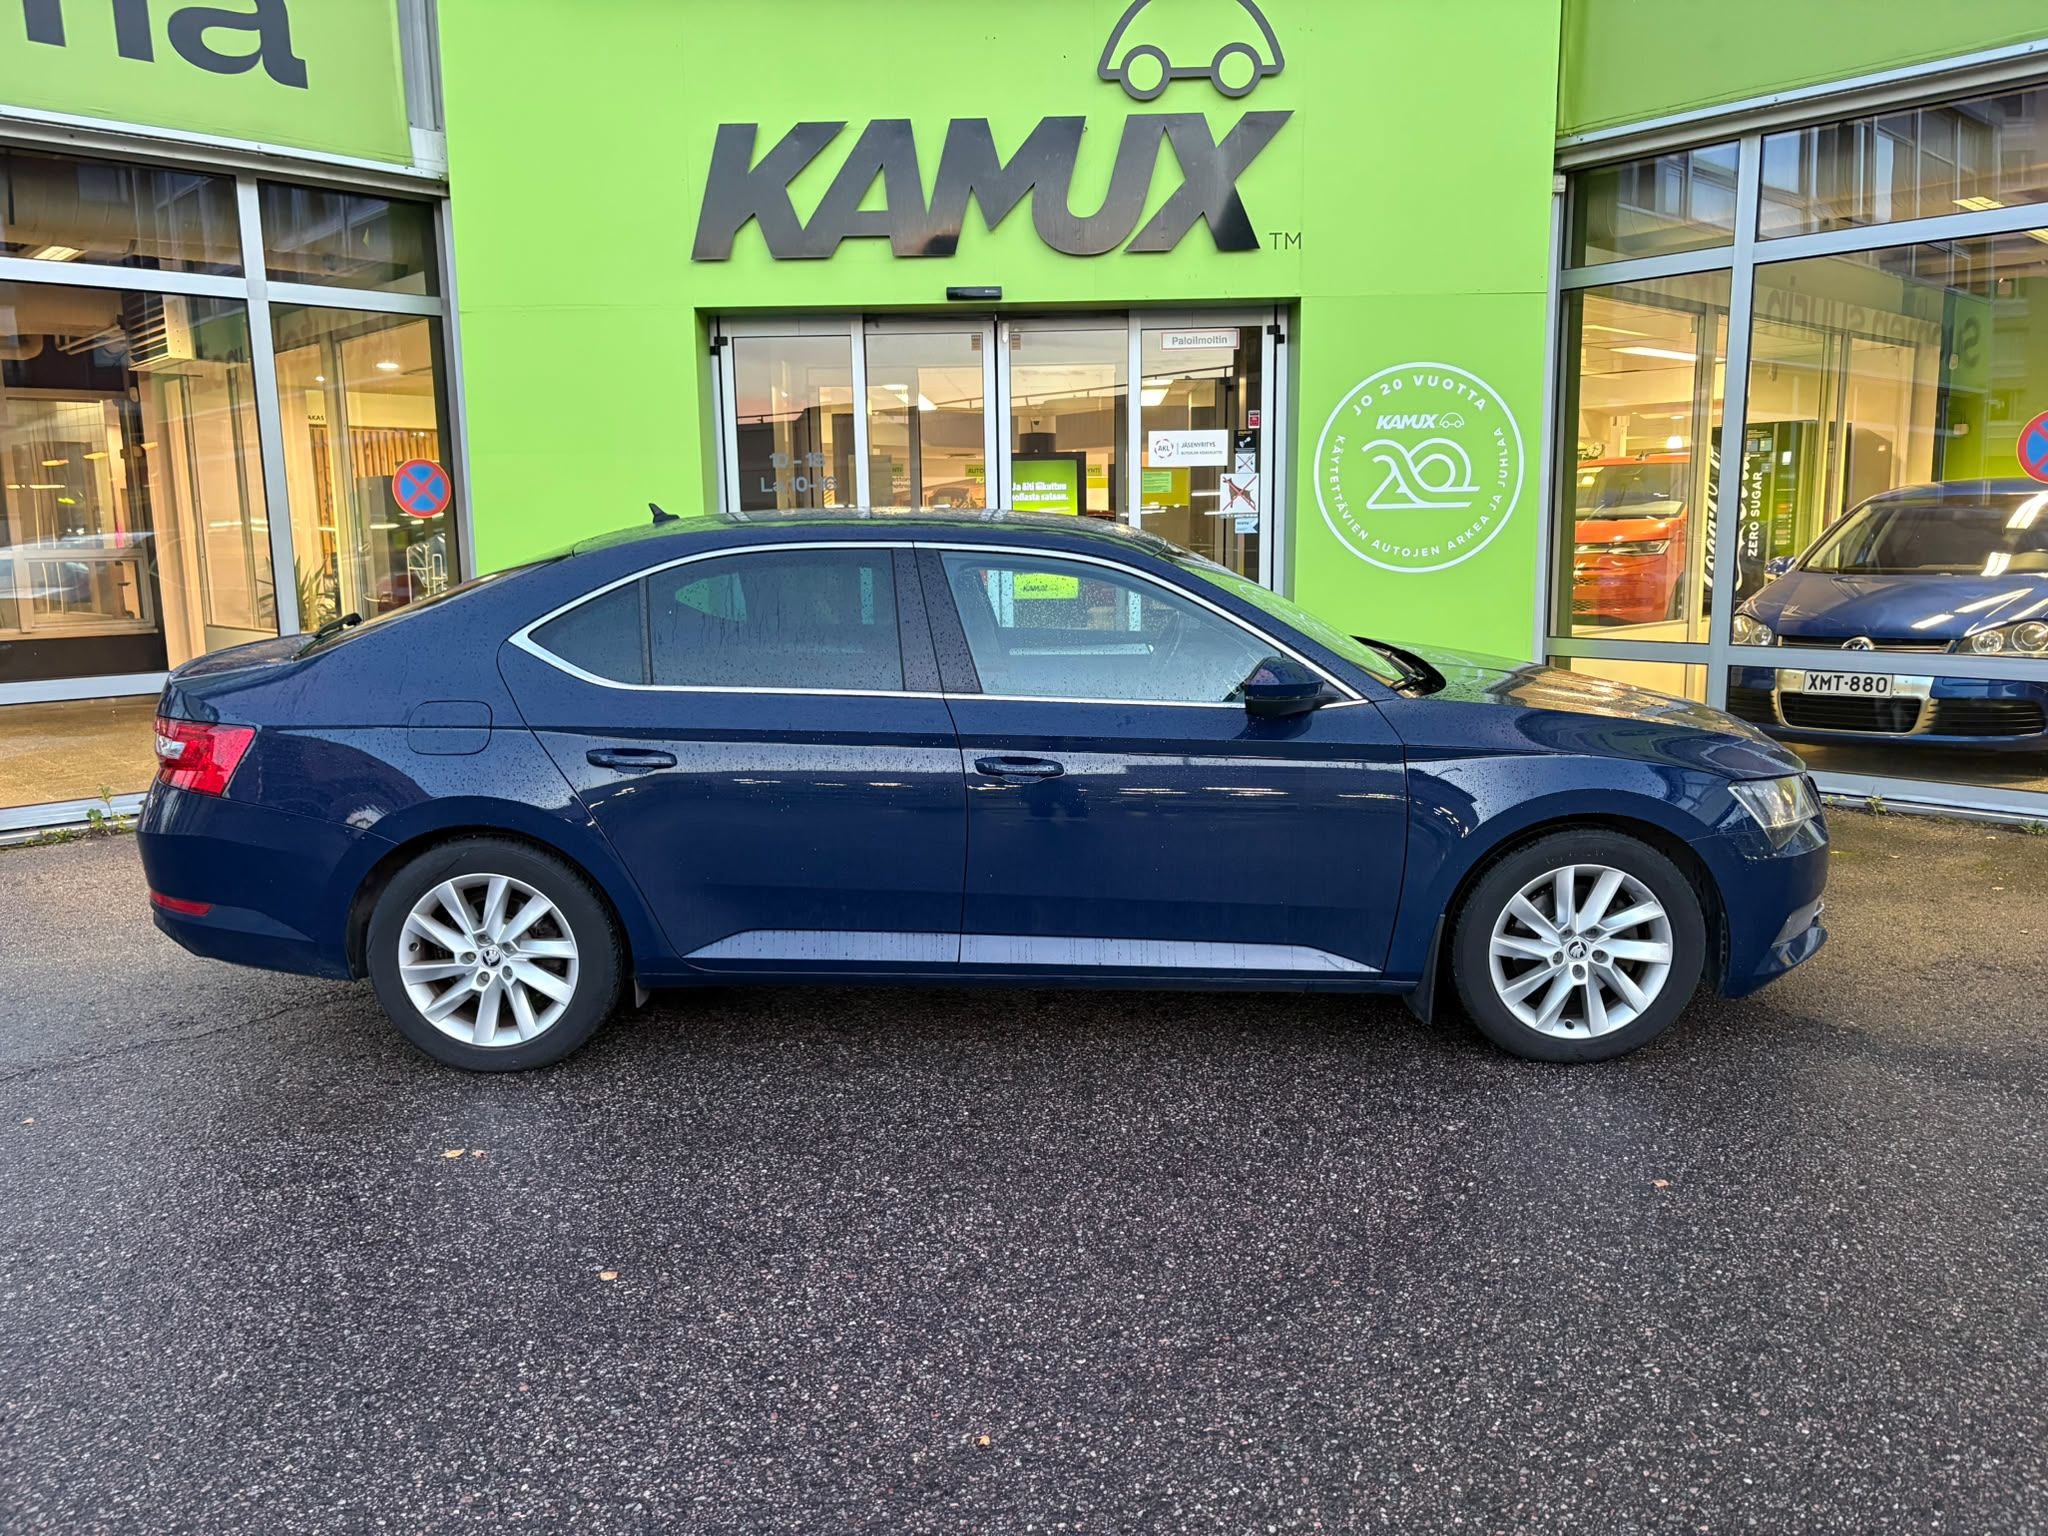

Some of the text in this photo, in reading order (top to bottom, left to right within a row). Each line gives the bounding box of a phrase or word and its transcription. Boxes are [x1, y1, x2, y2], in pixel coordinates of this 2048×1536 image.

[691, 110, 1302, 261] KAMUX TM
[1172, 335, 1228, 346] Paloilmoitin
[1353, 375, 1486, 416] JO 20 VUOTTA
[1376, 414, 1439, 430] KAMUX
[1329, 428, 1508, 557] KÄYTETTÄVIEN AUTOJEN ARKEA JA JUHLAA
[1748, 472, 1763, 557] ZERO SUGAR
[1807, 674, 1888, 693] XMT-880
